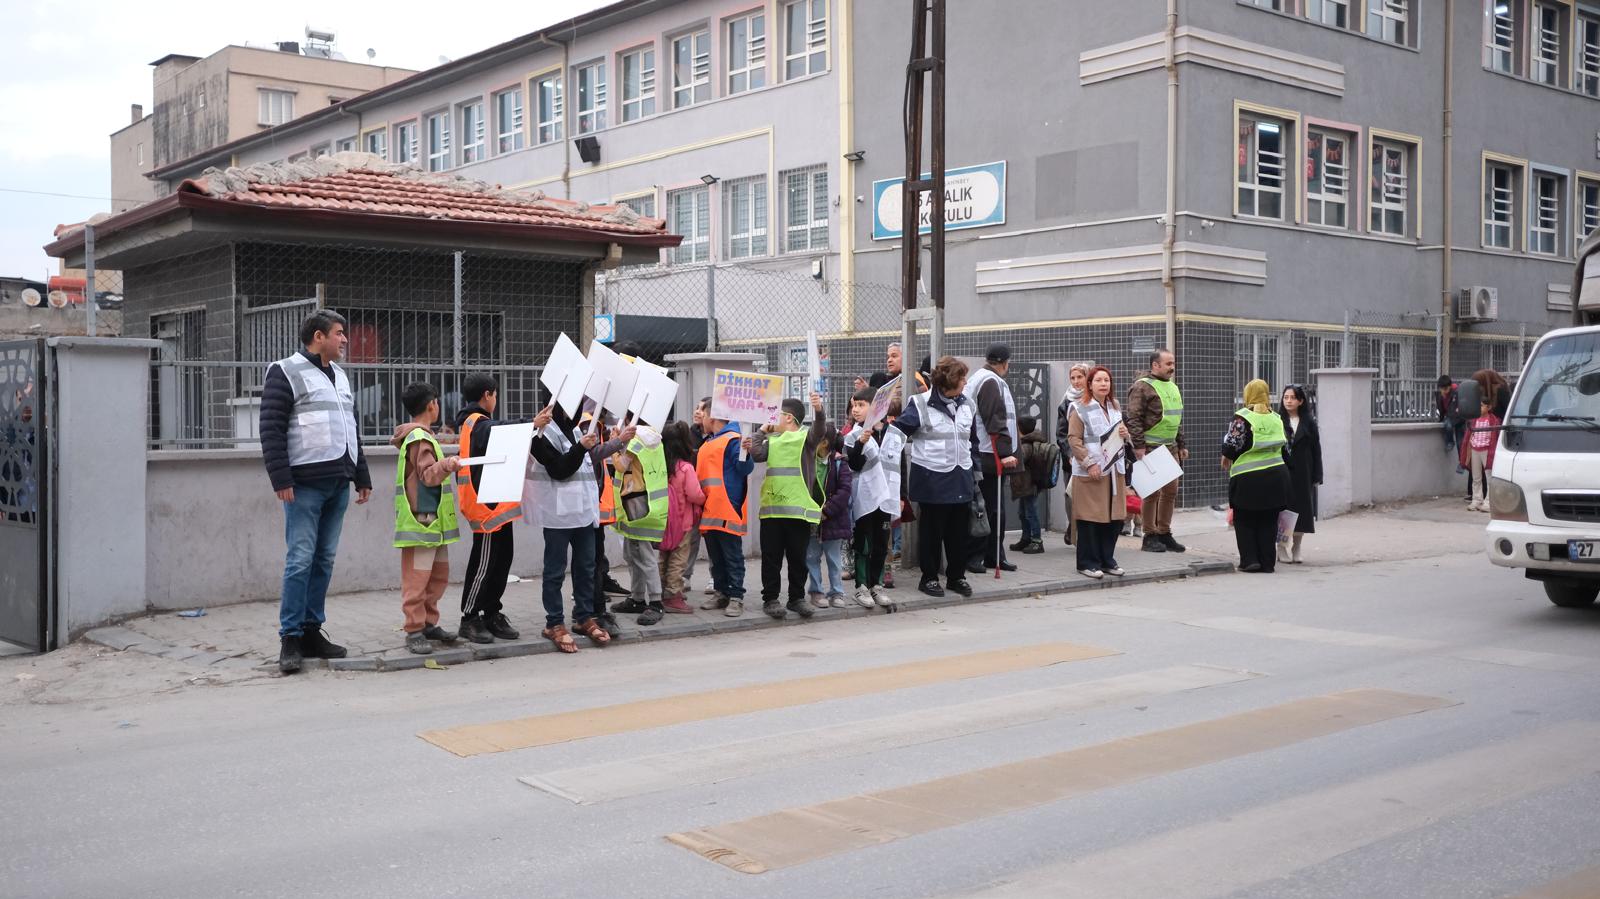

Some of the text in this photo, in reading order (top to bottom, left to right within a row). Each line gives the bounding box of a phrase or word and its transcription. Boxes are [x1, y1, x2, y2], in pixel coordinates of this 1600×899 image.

[925, 187, 973, 207] AALIK
[724, 386, 761, 400] OKUL
[727, 398, 755, 410] VAR
[1577, 542, 1594, 557] 27
